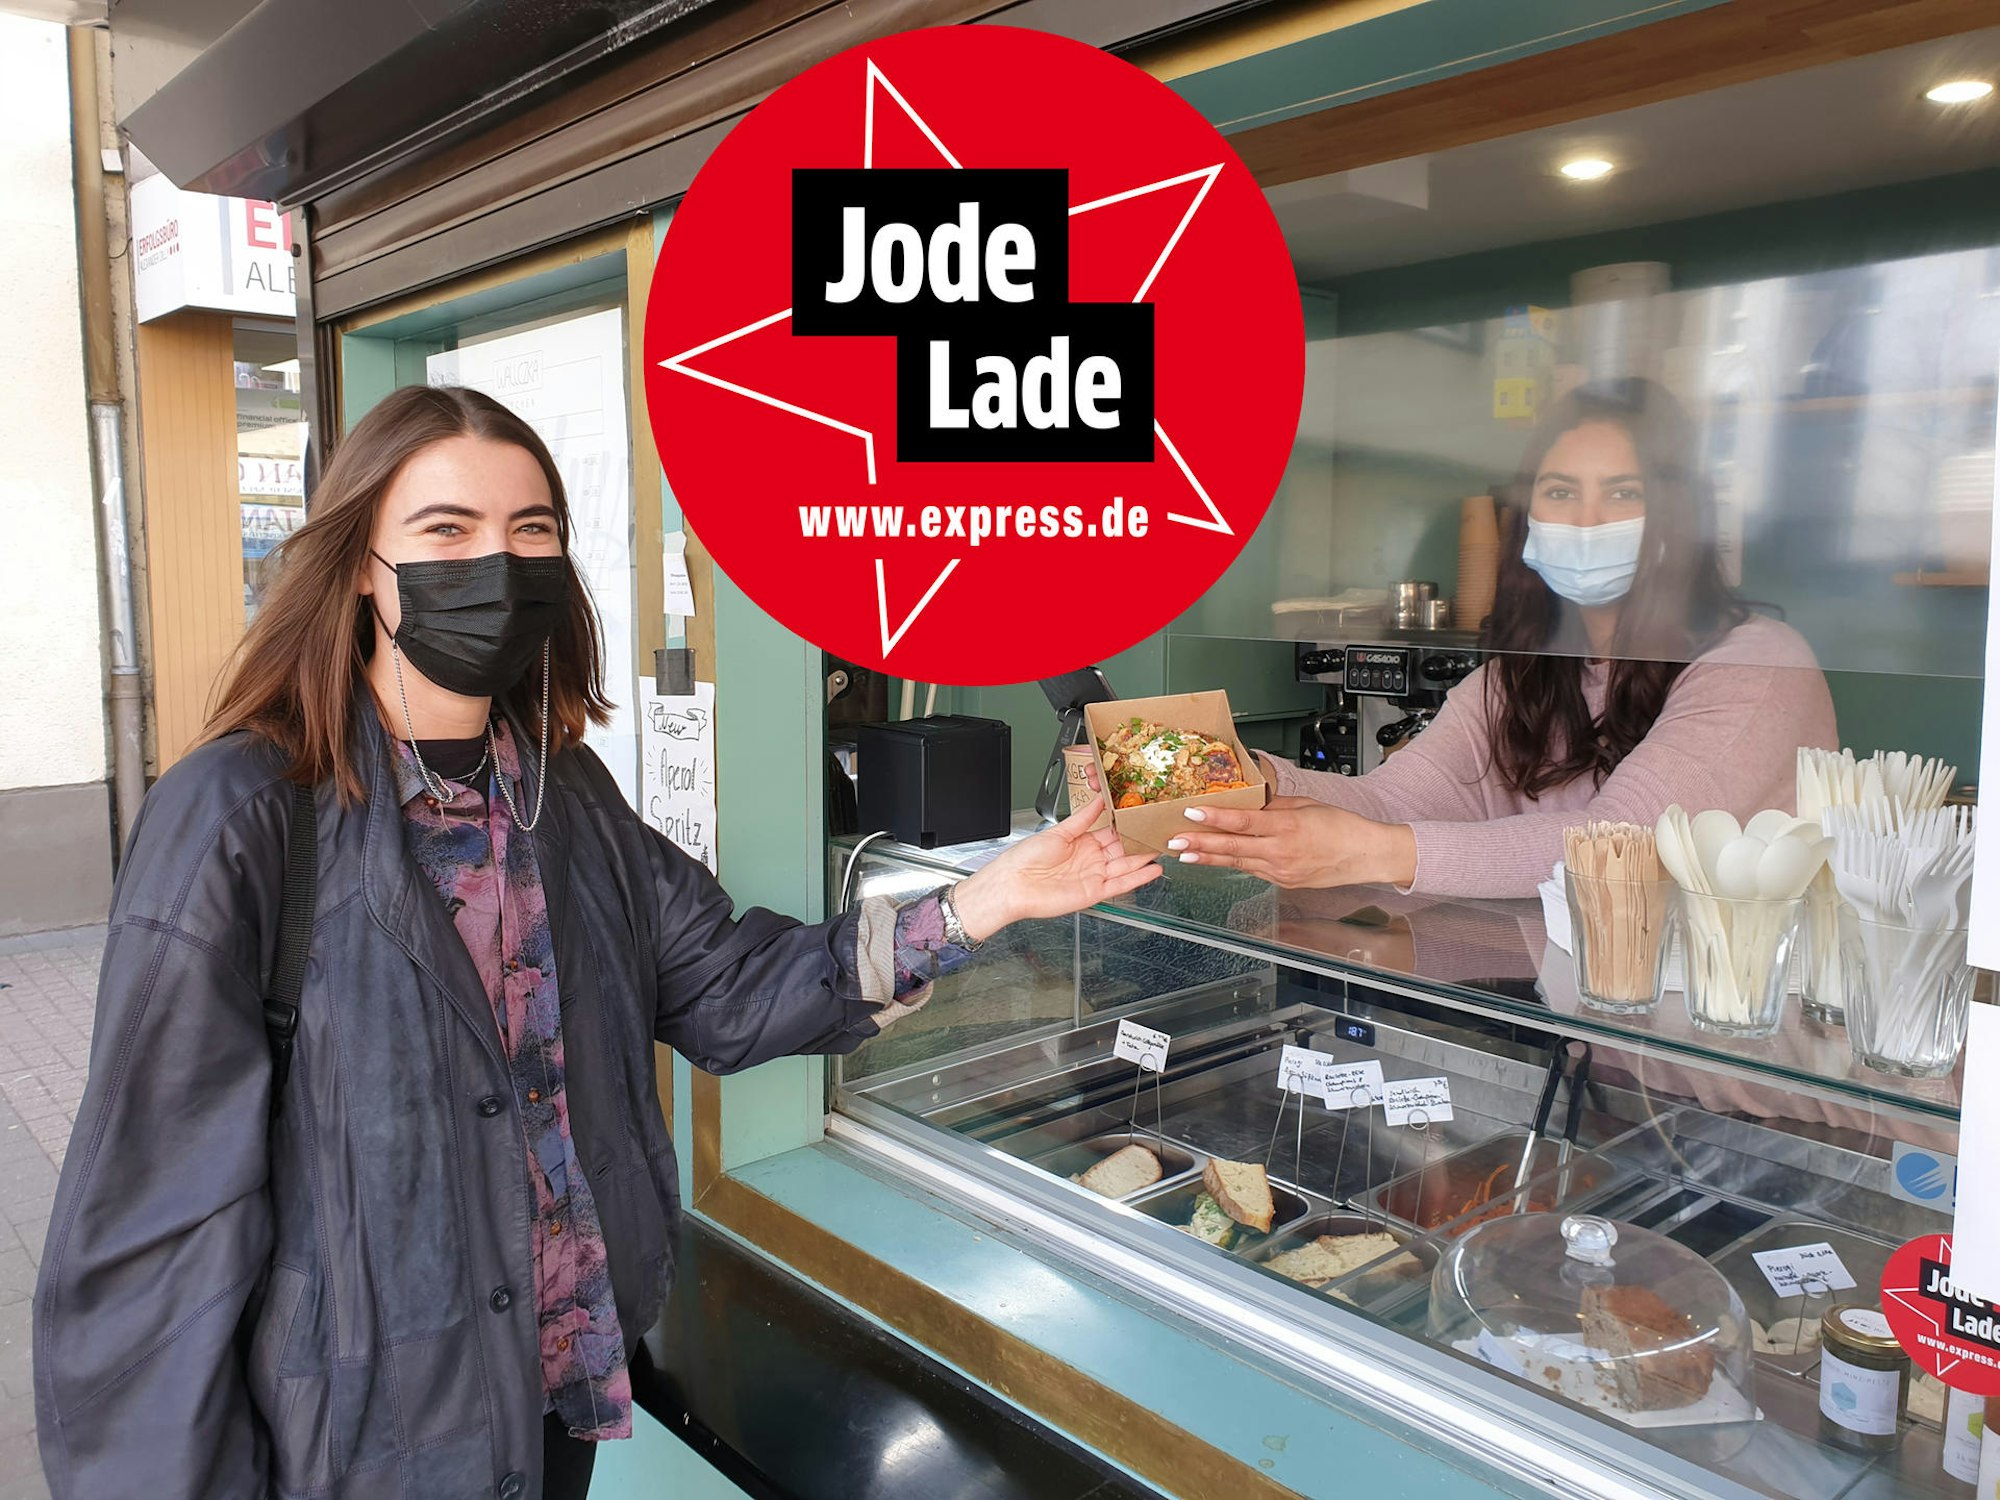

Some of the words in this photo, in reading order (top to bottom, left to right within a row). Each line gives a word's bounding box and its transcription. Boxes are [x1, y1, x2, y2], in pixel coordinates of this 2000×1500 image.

[138, 219, 179, 257] ERFOLGSBÜRO
[660, 747, 698, 800] Aperol
[650, 795, 703, 846] Spritz
[1926, 1268, 1985, 1308] Jo
